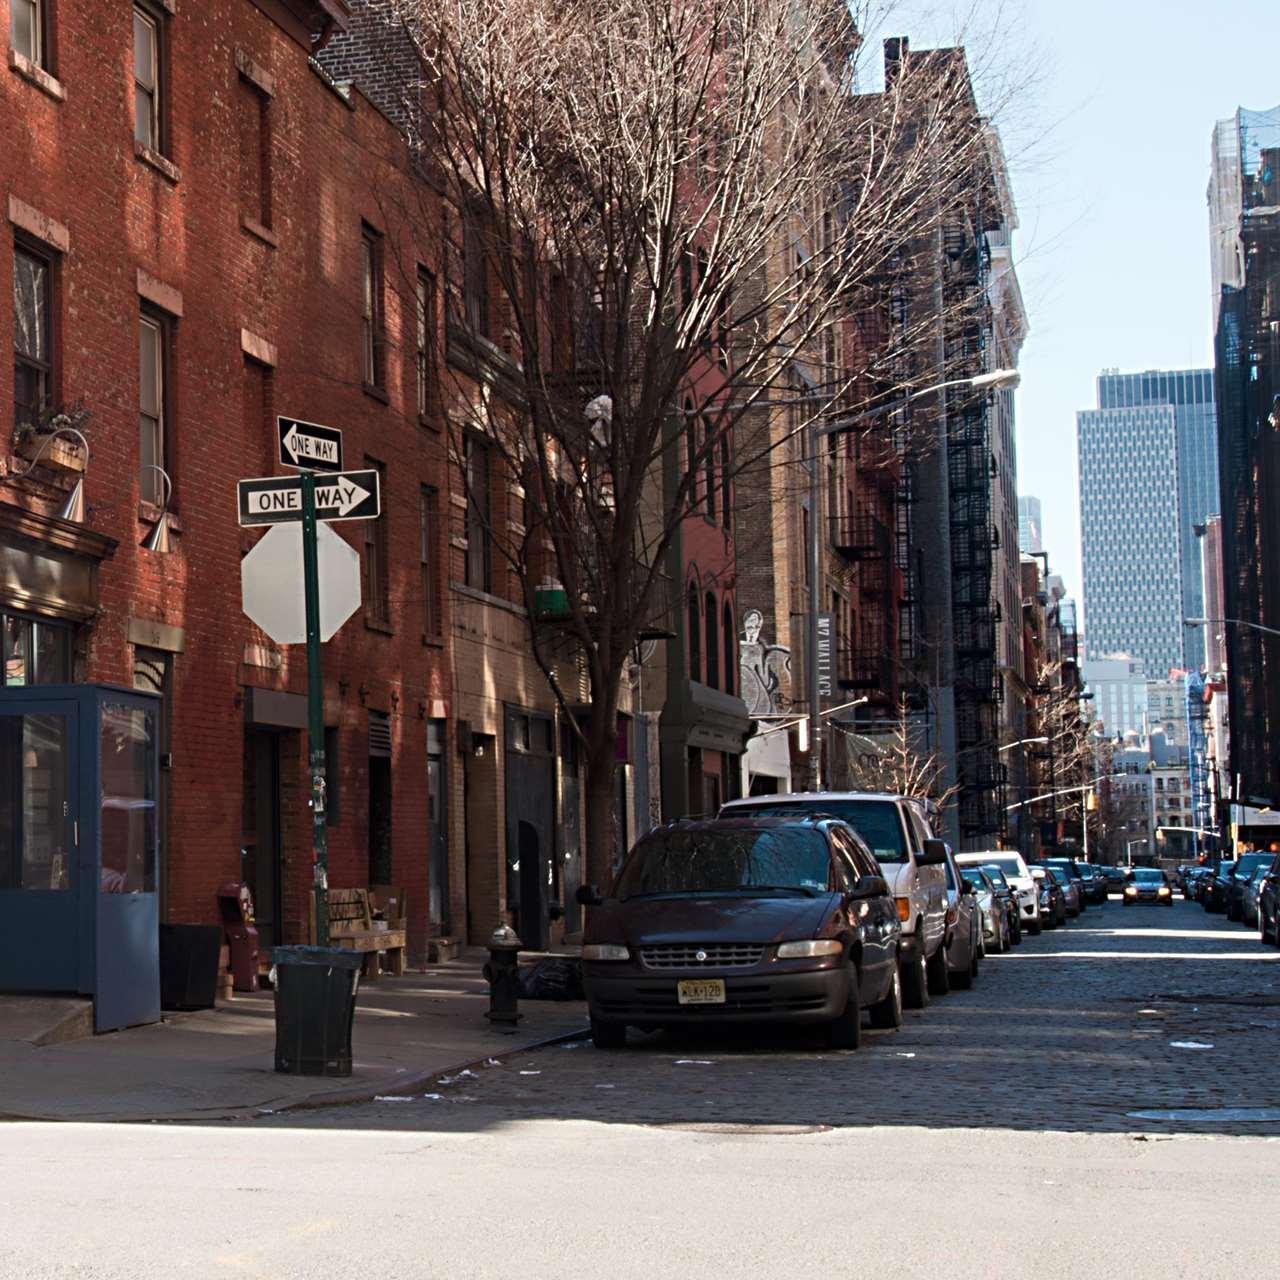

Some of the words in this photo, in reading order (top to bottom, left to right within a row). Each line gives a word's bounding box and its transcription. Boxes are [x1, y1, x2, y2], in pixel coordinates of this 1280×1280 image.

[291, 435, 310, 455] ONE
[315, 440, 333, 459] WAY
[259, 491, 298, 510] ONE
[316, 487, 356, 509] WAY
